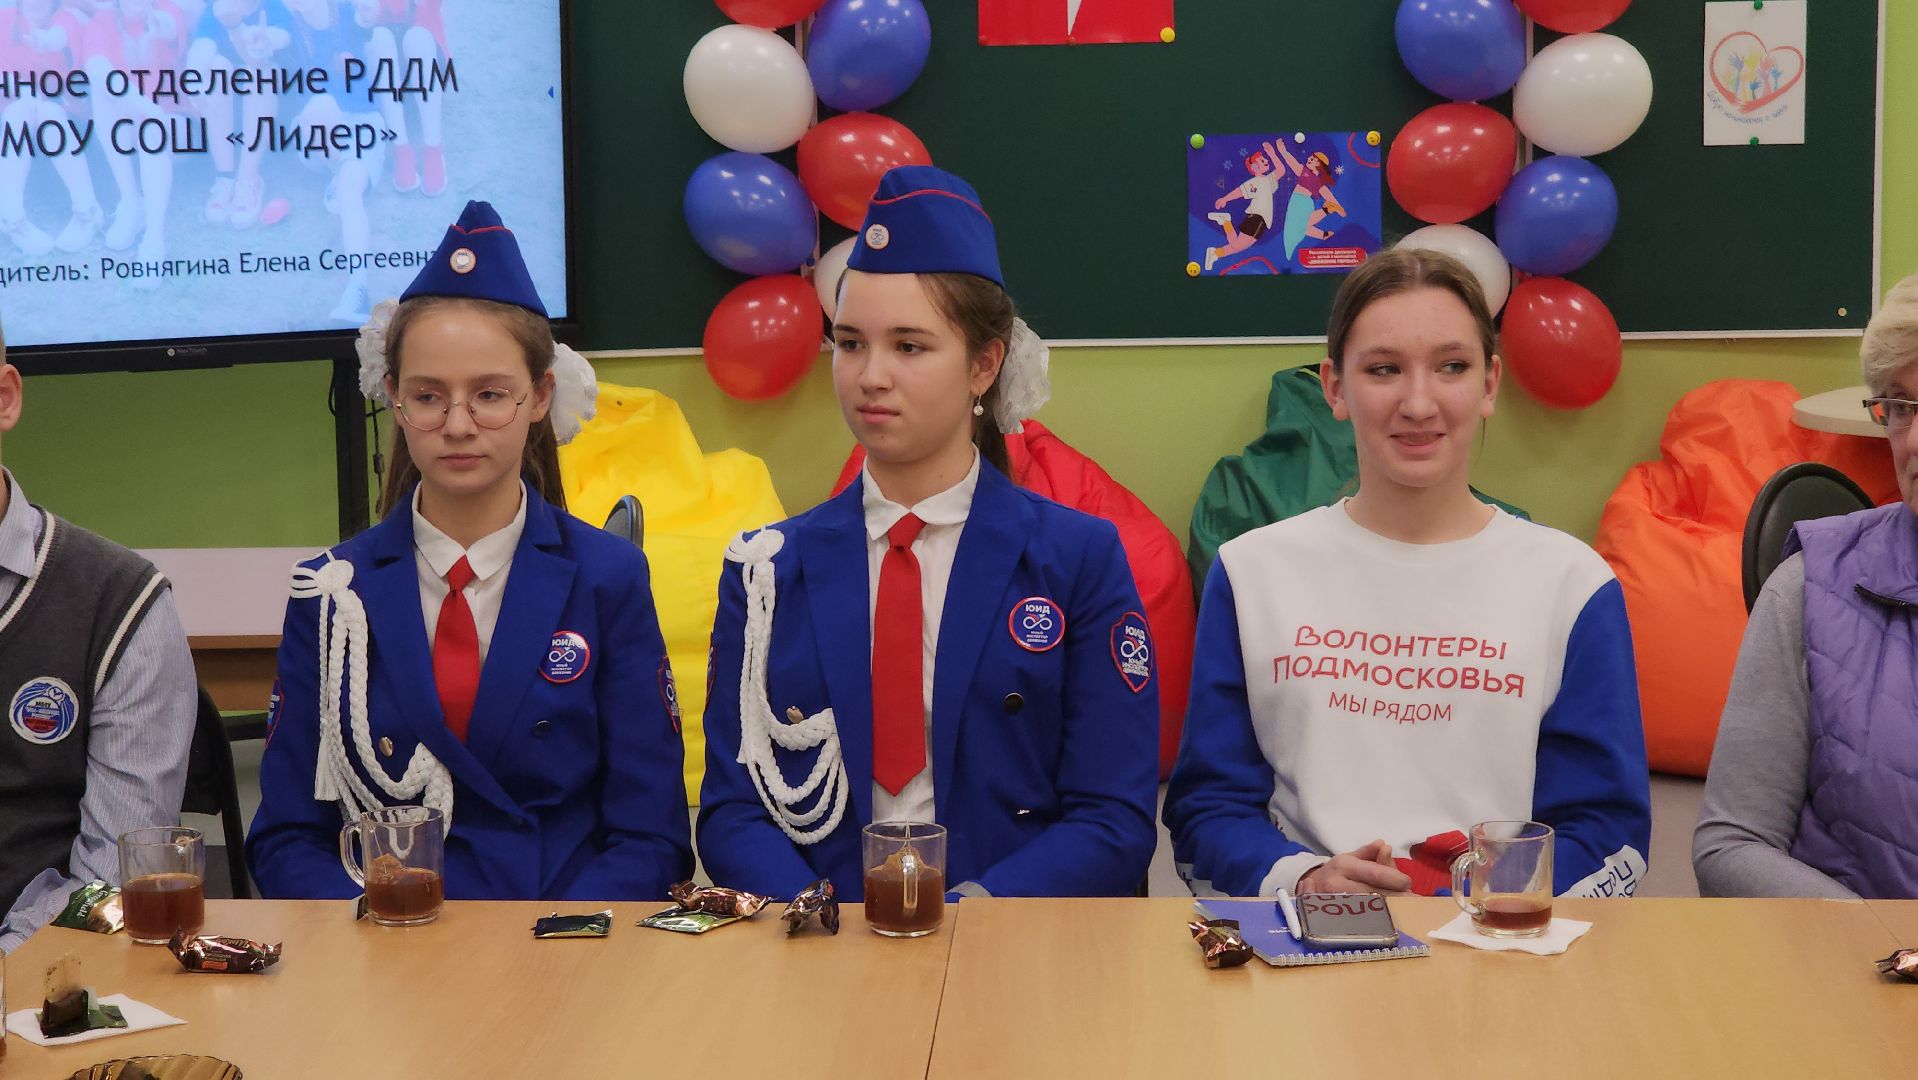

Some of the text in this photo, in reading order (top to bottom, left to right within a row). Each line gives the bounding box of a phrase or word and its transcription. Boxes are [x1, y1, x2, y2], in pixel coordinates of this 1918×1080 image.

[106, 67, 328, 104] отделение
[345, 58, 458, 103] РДДМ
[1, 116, 397, 159] МОУ СОШ «Лидер»
[101, 257, 231, 280] Ровнягина
[239, 251, 310, 273] Елена
[318, 248, 434, 274] Сергеевн
[1025, 604, 1051, 615] ЮИД
[551, 638, 575, 648] ЮИД
[1125, 625, 1145, 642] ЮИД
[1295, 625, 1507, 661] ВОЛОНТЕРЫ
[1273, 655, 1525, 698] ПОДМОСКОВЬЯ
[1329, 692, 1452, 724] МЫ РЯДОМ
